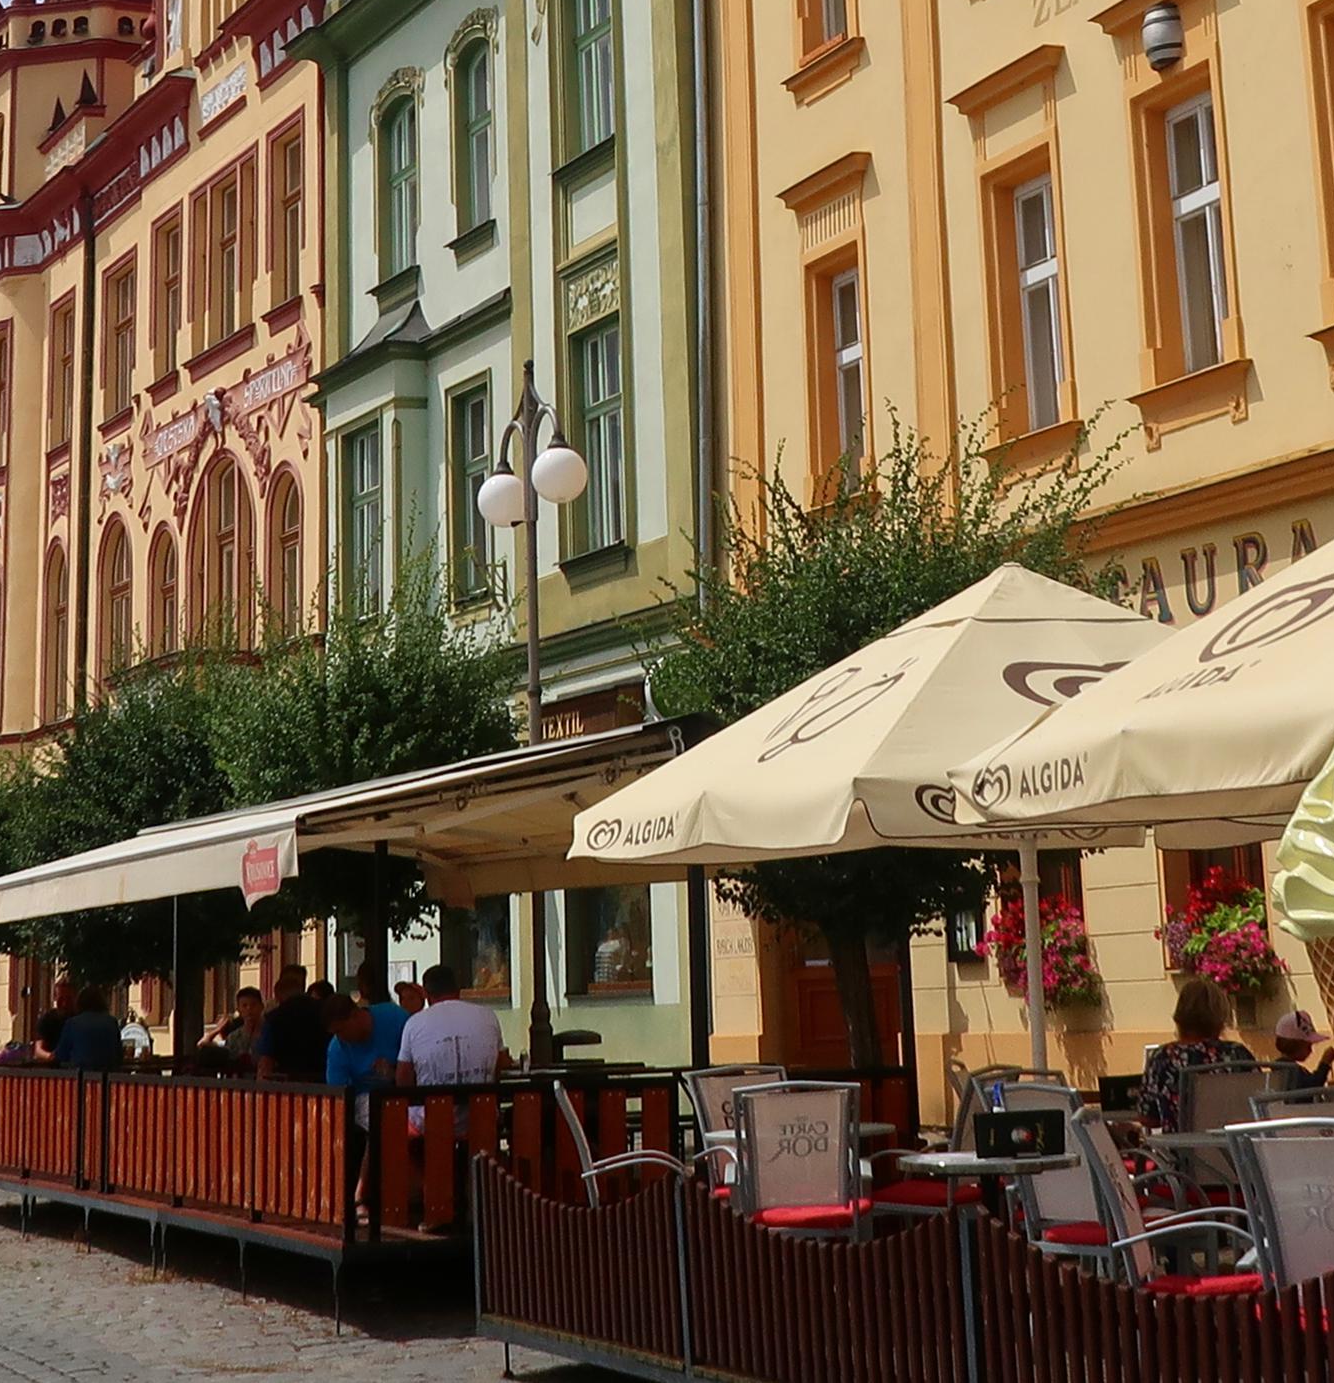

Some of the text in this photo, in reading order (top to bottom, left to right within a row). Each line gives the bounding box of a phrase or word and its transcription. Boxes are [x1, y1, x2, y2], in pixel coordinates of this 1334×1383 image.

[541, 711, 584, 740] TEXTIL
[1020, 752, 1085, 799] ALGIDA
[623, 814, 674, 847] ALGIDA
